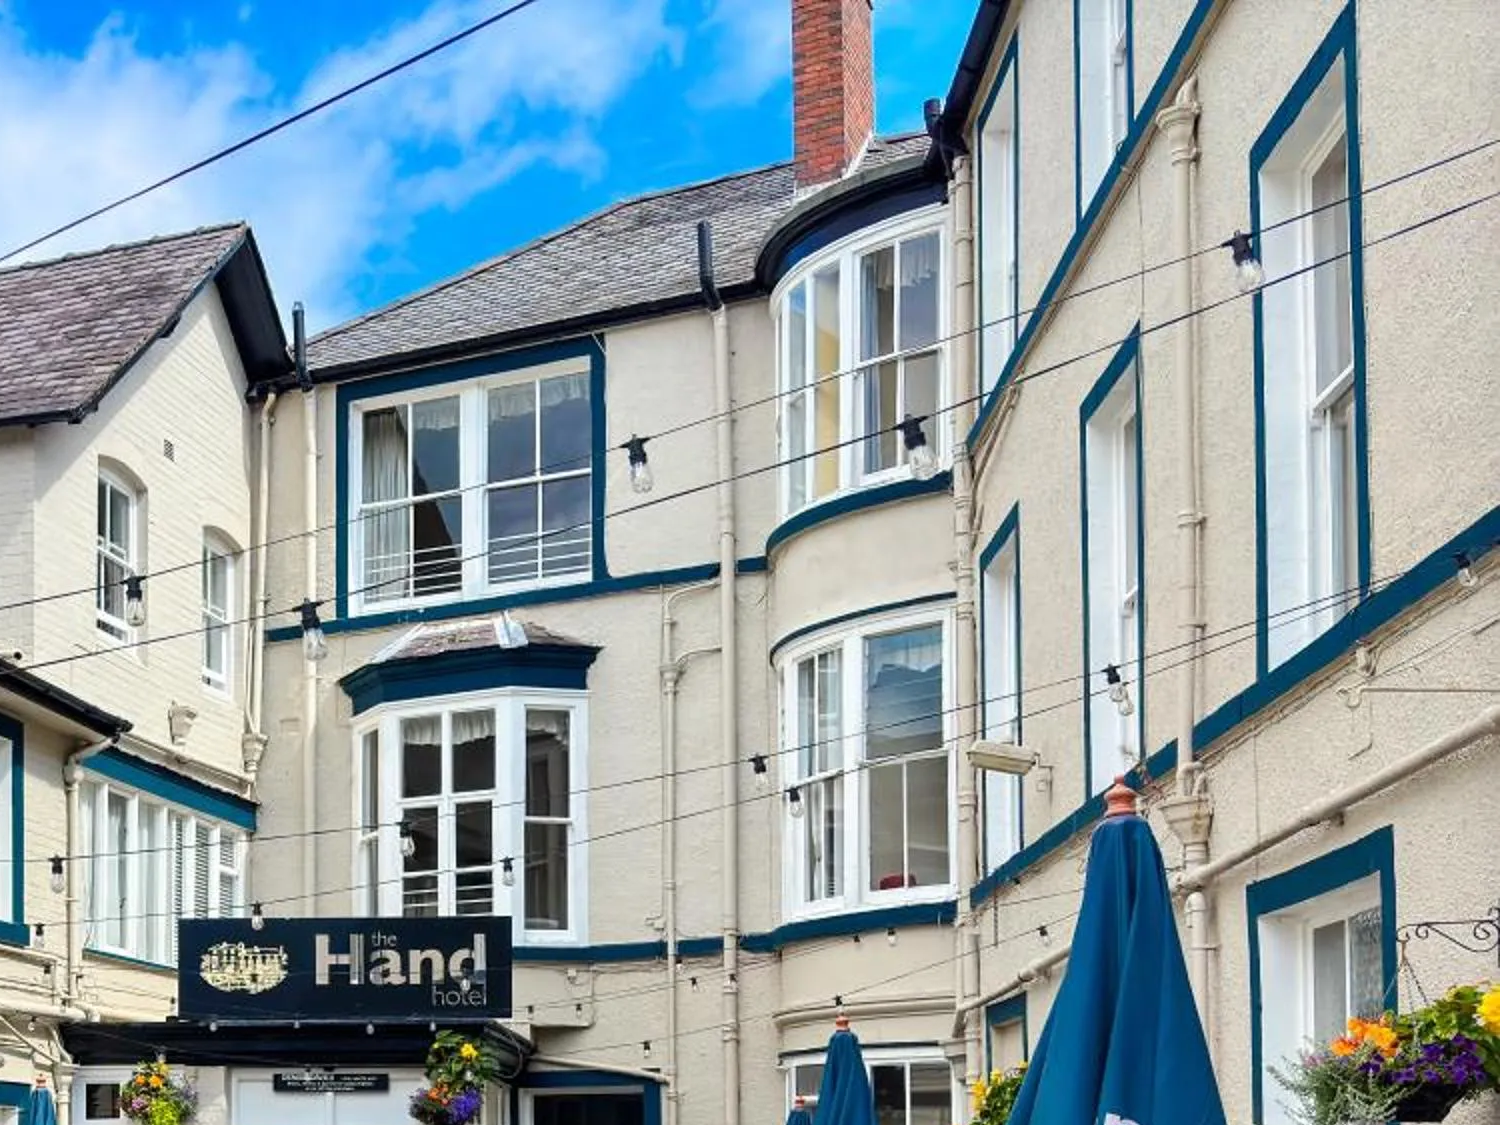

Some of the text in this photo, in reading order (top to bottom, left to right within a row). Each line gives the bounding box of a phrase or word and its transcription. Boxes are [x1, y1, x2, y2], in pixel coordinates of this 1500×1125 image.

[371, 931, 398, 947] the
[315, 933, 487, 986] Hand
[431, 983, 487, 1006] hotel
